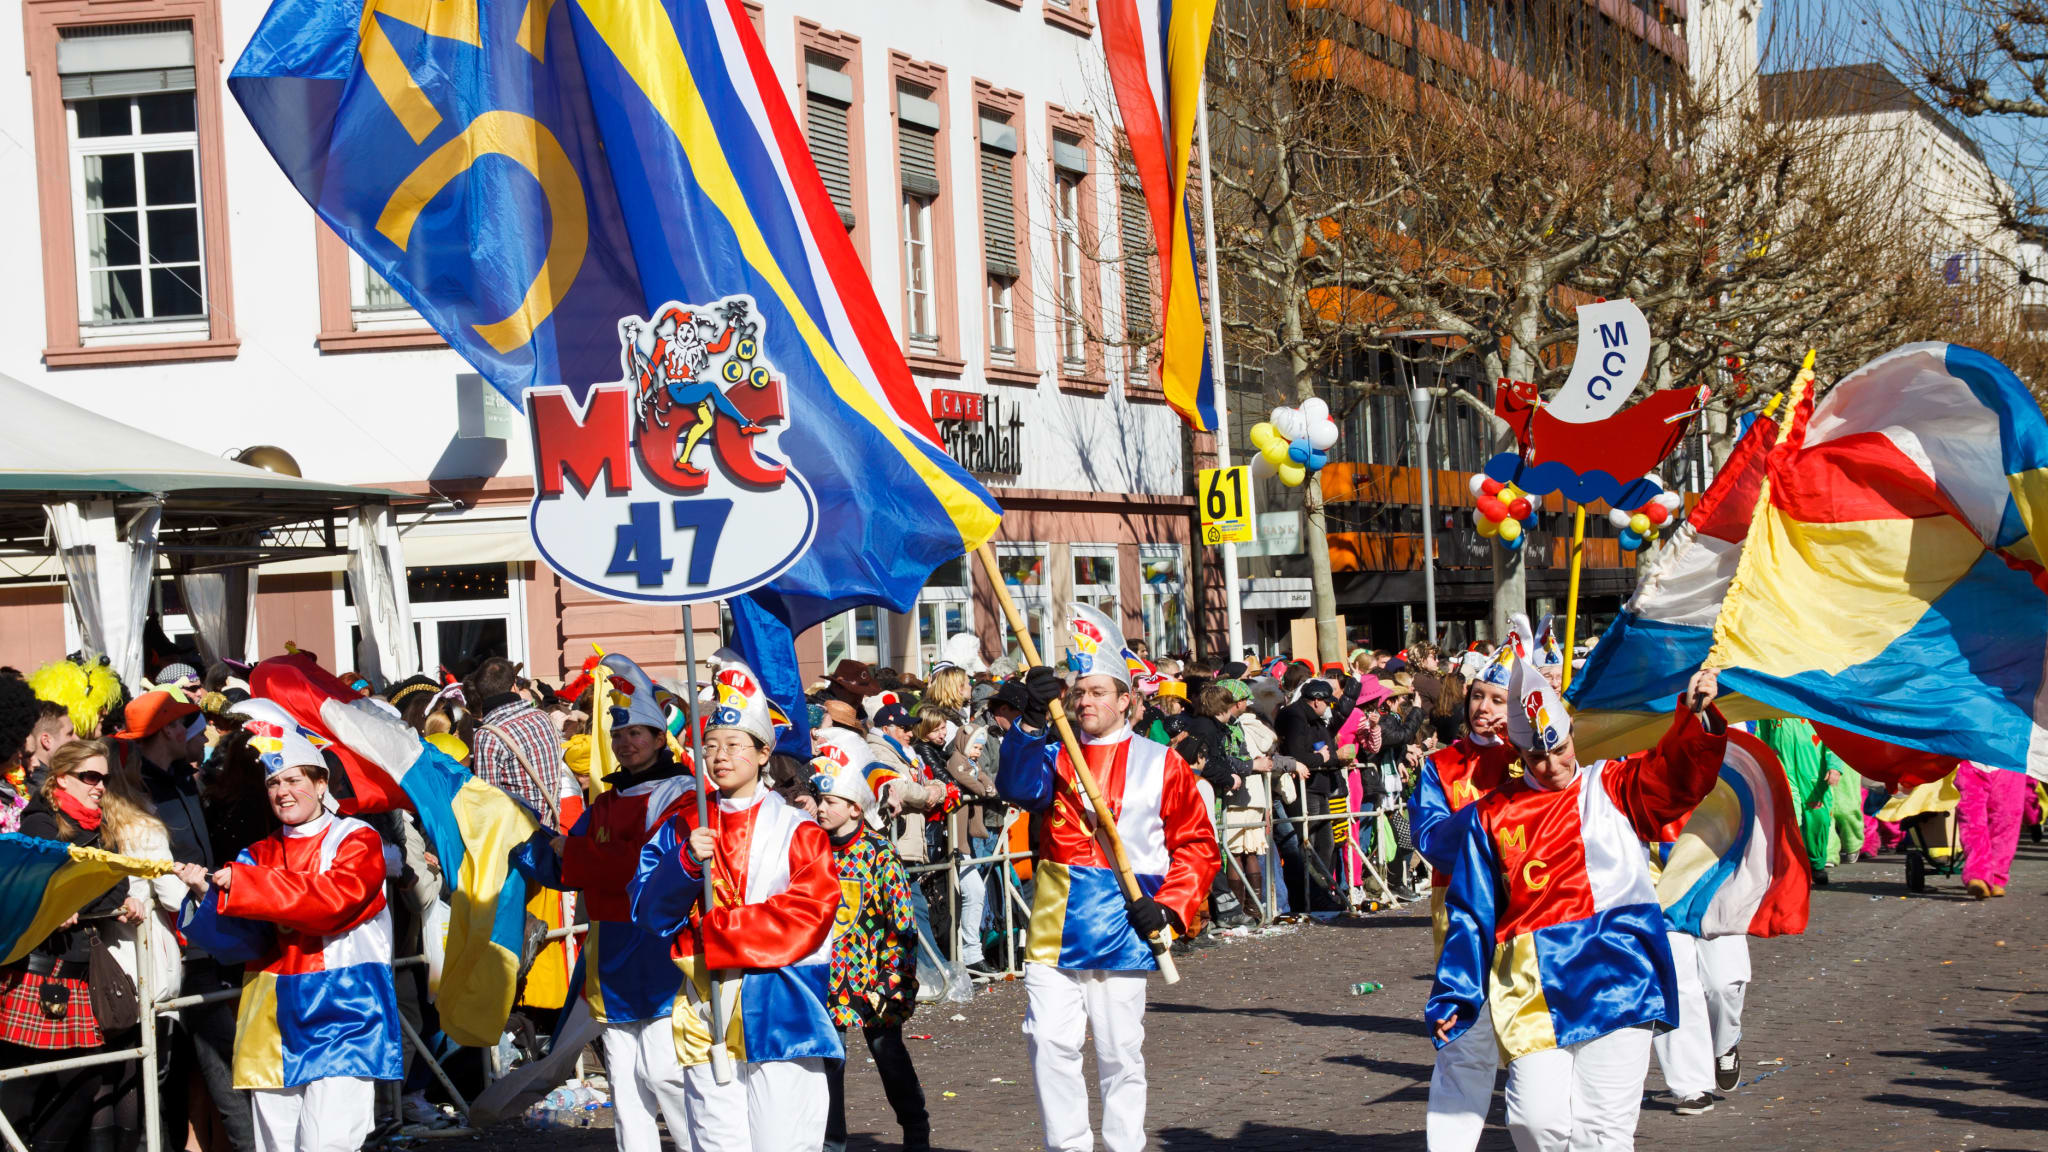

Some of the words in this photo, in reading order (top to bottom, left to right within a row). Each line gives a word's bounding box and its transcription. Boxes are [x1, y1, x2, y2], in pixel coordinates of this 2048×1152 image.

[742, 343, 753, 356] M
[529, 376, 788, 496] MCC
[1207, 468, 1243, 520] 61
[731, 672, 746, 688] M
[728, 694, 739, 705] C
[723, 711, 736, 723] C
[829, 748, 841, 760] M
[820, 778, 830, 790] C
[1453, 778, 1480, 809] M
[1500, 824, 1527, 860] M
[1523, 860, 1551, 890] C
